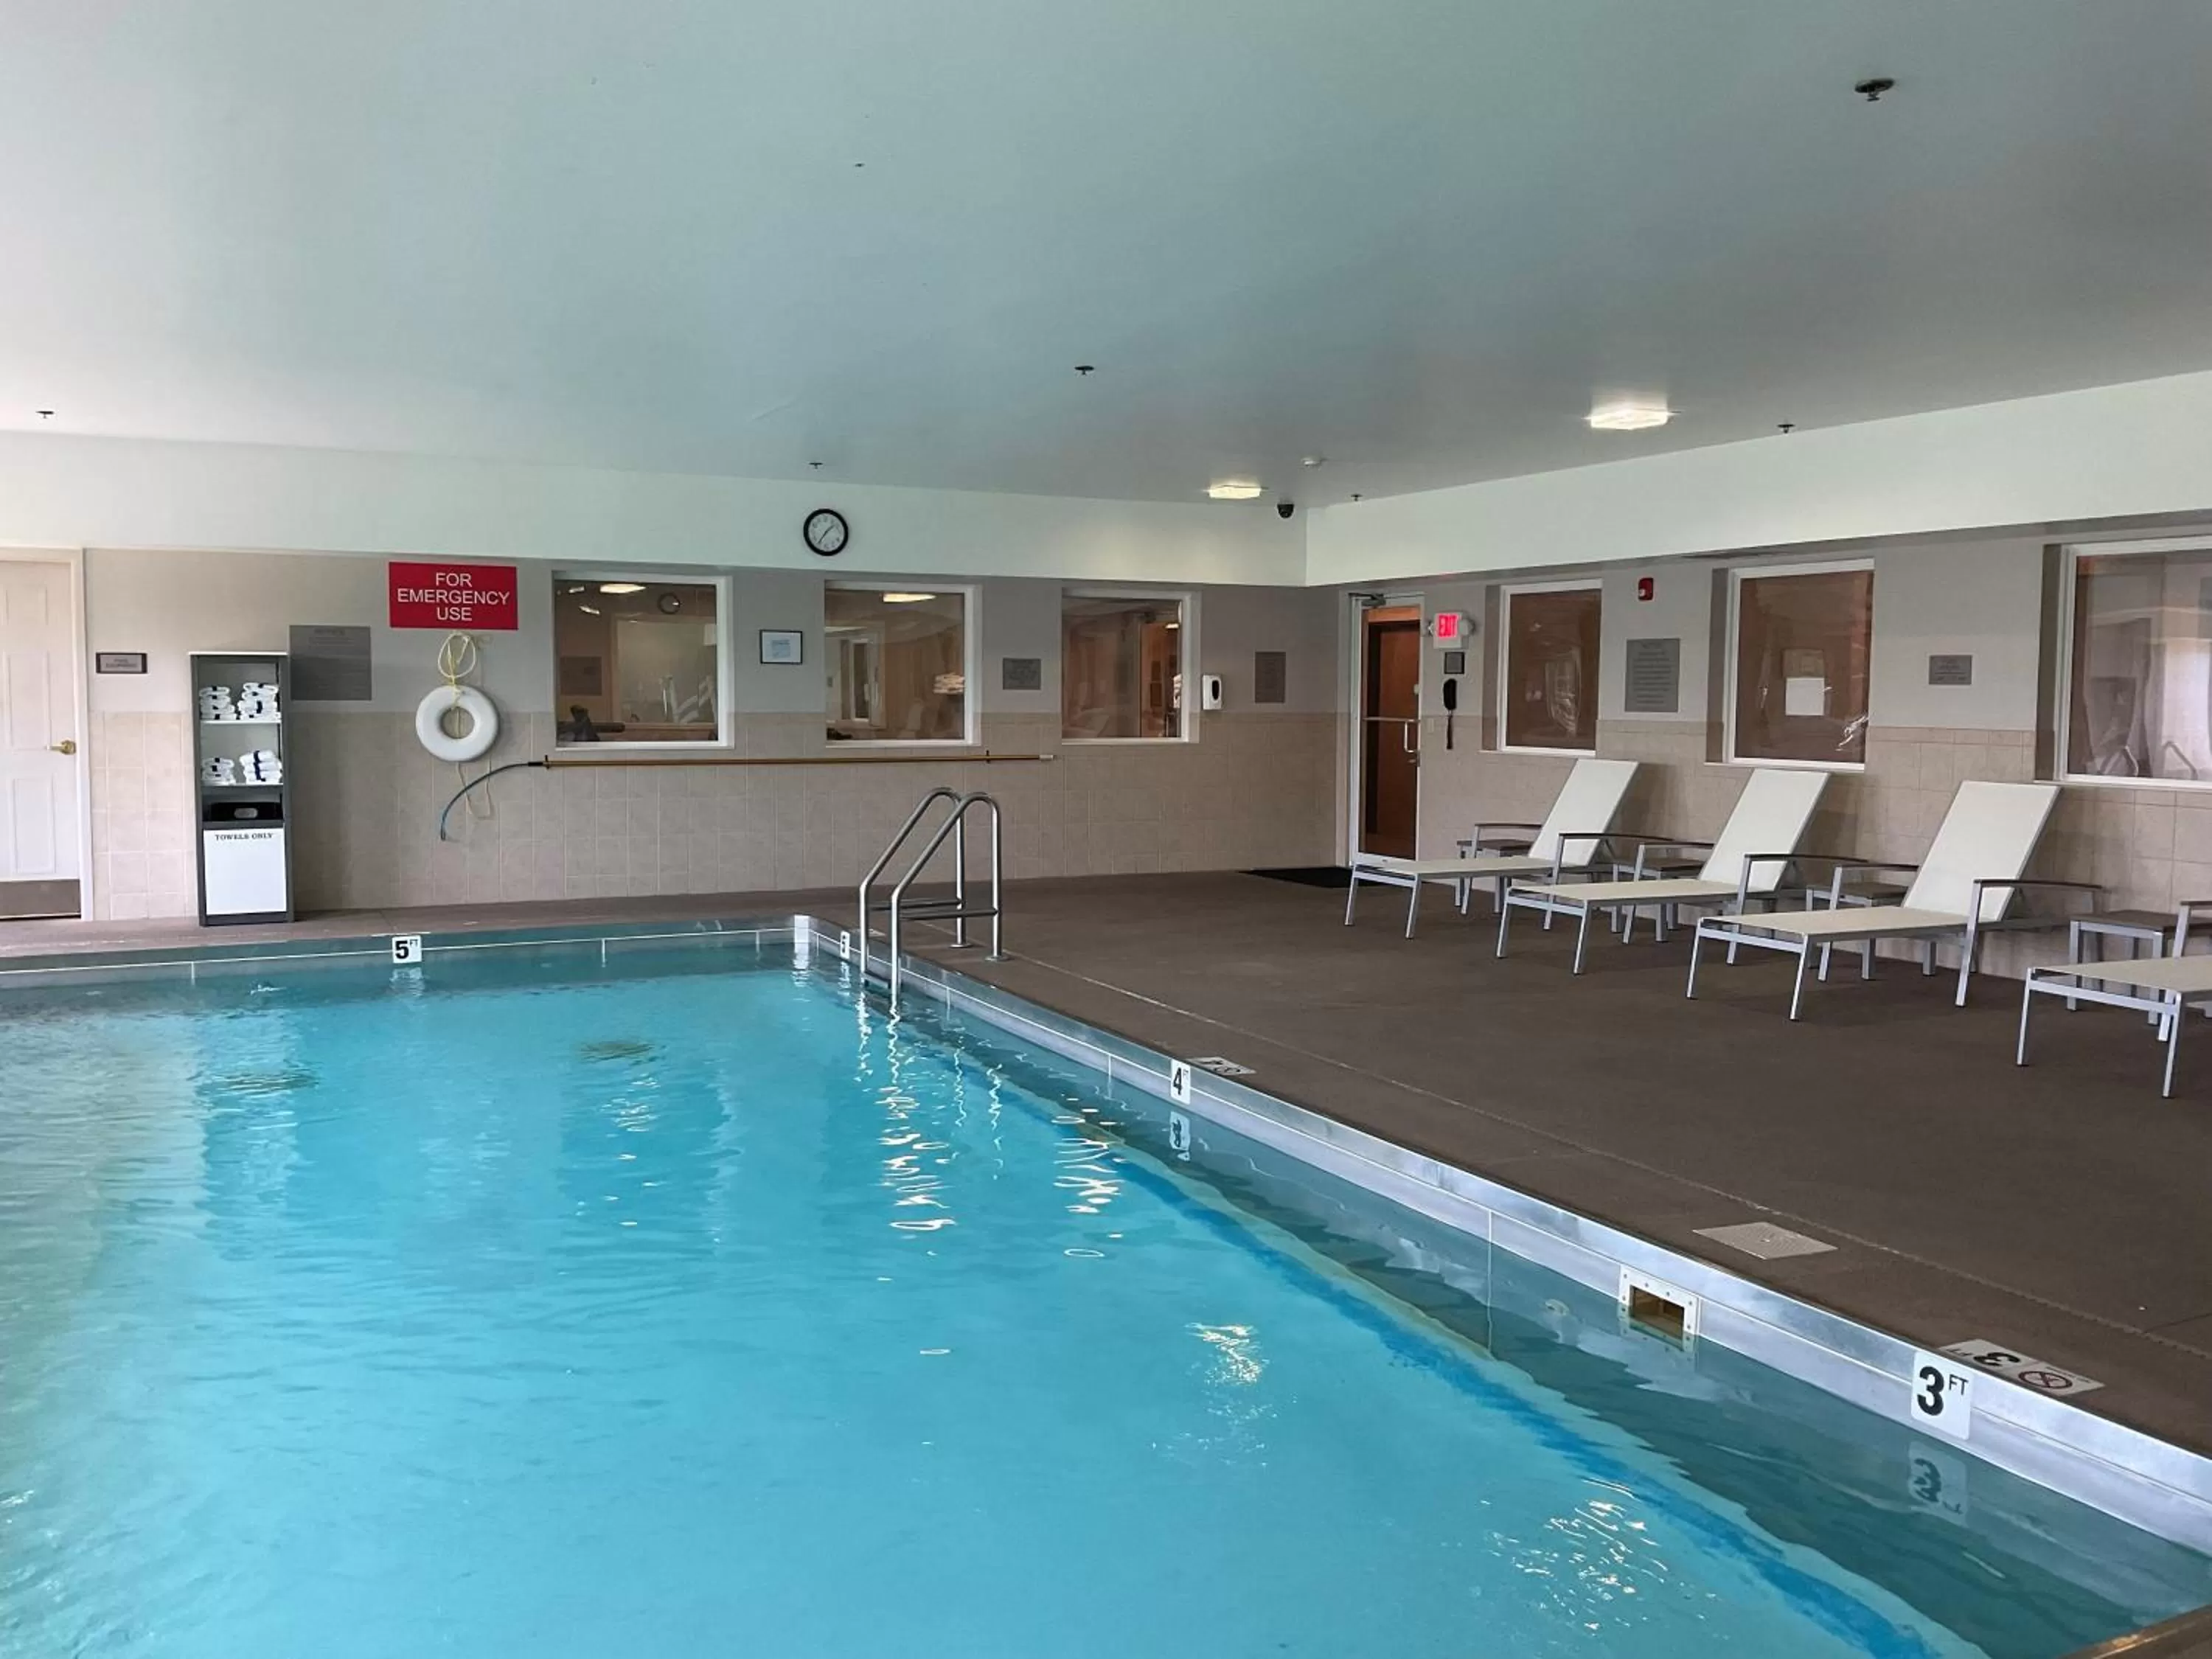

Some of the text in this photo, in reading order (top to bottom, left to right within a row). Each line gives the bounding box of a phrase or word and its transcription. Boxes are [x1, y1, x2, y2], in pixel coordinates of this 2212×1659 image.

[435, 572, 473, 588] FOR
[397, 588, 510, 605] EMERGENCY
[437, 606, 473, 622] USE
[395, 940, 409, 959] 5
[1173, 1067, 1183, 1096] 4
[1917, 1366, 1969, 1416] 3 FT
